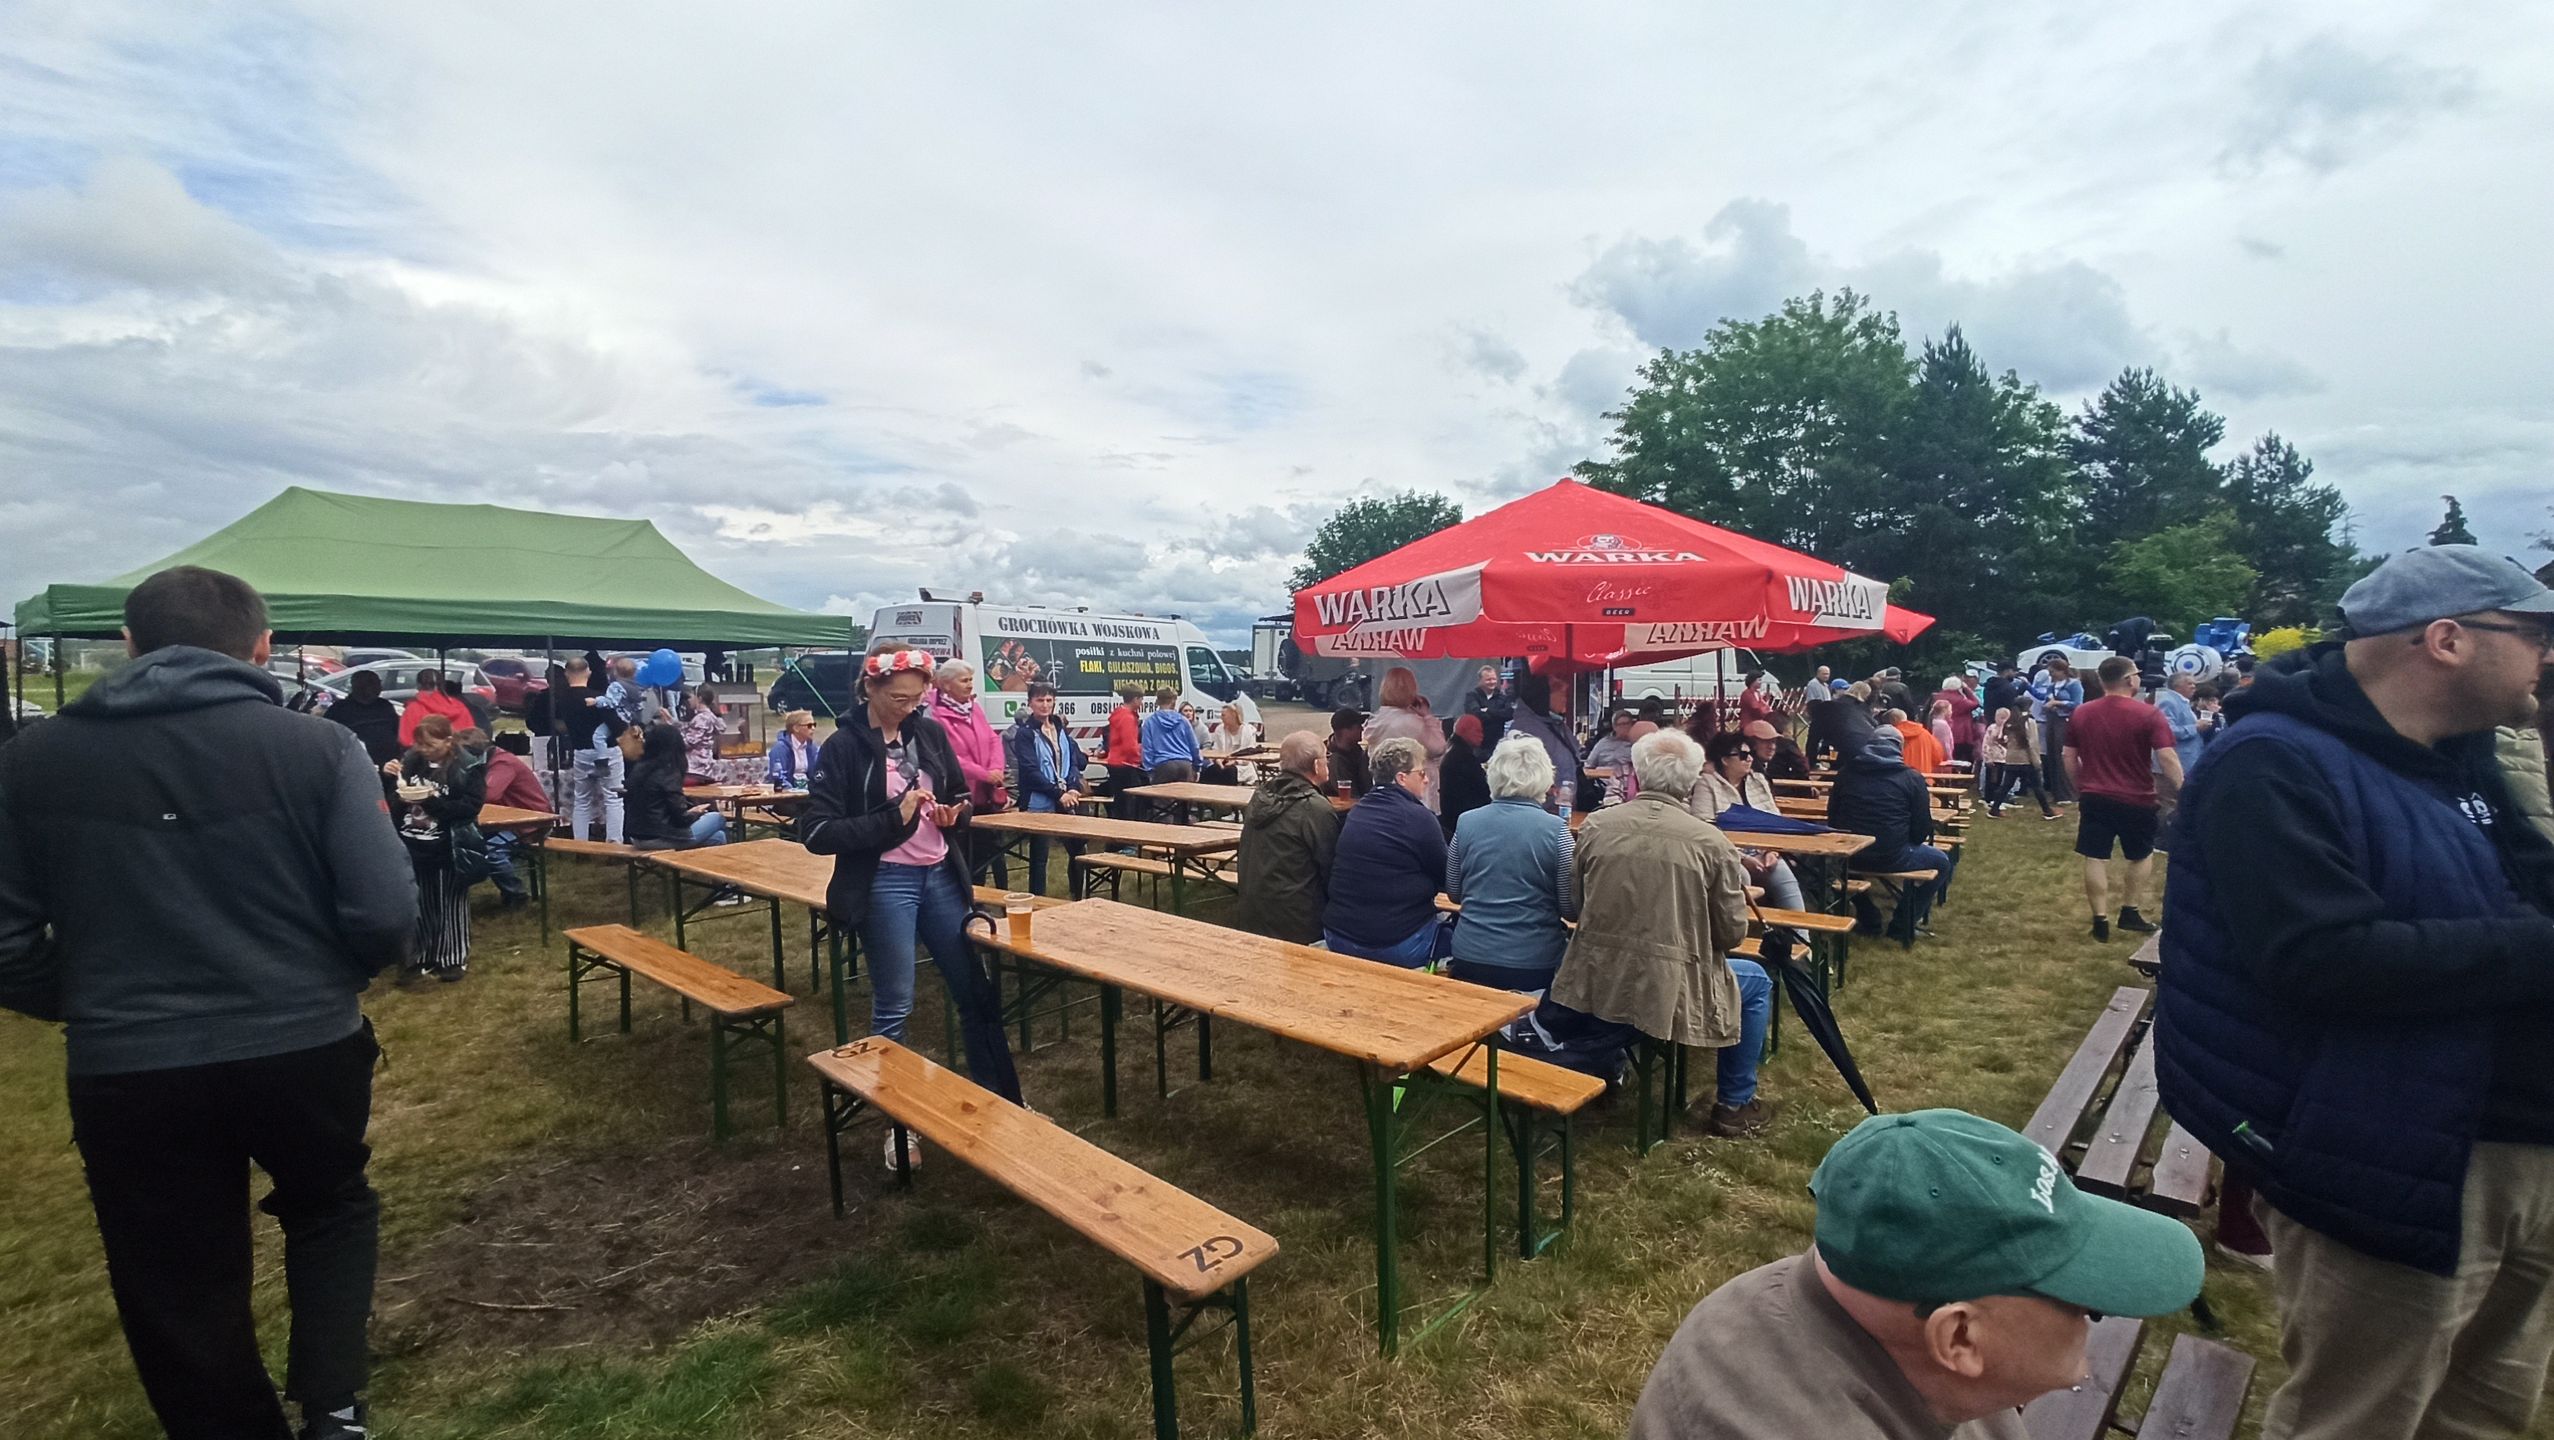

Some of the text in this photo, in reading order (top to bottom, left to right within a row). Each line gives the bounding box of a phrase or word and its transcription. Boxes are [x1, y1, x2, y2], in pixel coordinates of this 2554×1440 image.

[1523, 551, 1708, 563] WARKA
[1313, 580, 1451, 627] WARKA
[1586, 580, 1653, 604] Classic
[1785, 574, 1873, 620] WARKA
[998, 616, 1160, 640] GROCHÓWKA WOJSKOWA
[1075, 646, 1105, 658] posiłki
[1117, 648, 1144, 657] kuchni
[1147, 649, 1176, 660] polowej
[1080, 660, 1105, 673] FLAKI,
[1059, 702, 1076, 715] 366
[1176, 1235, 1244, 1273] GZ
